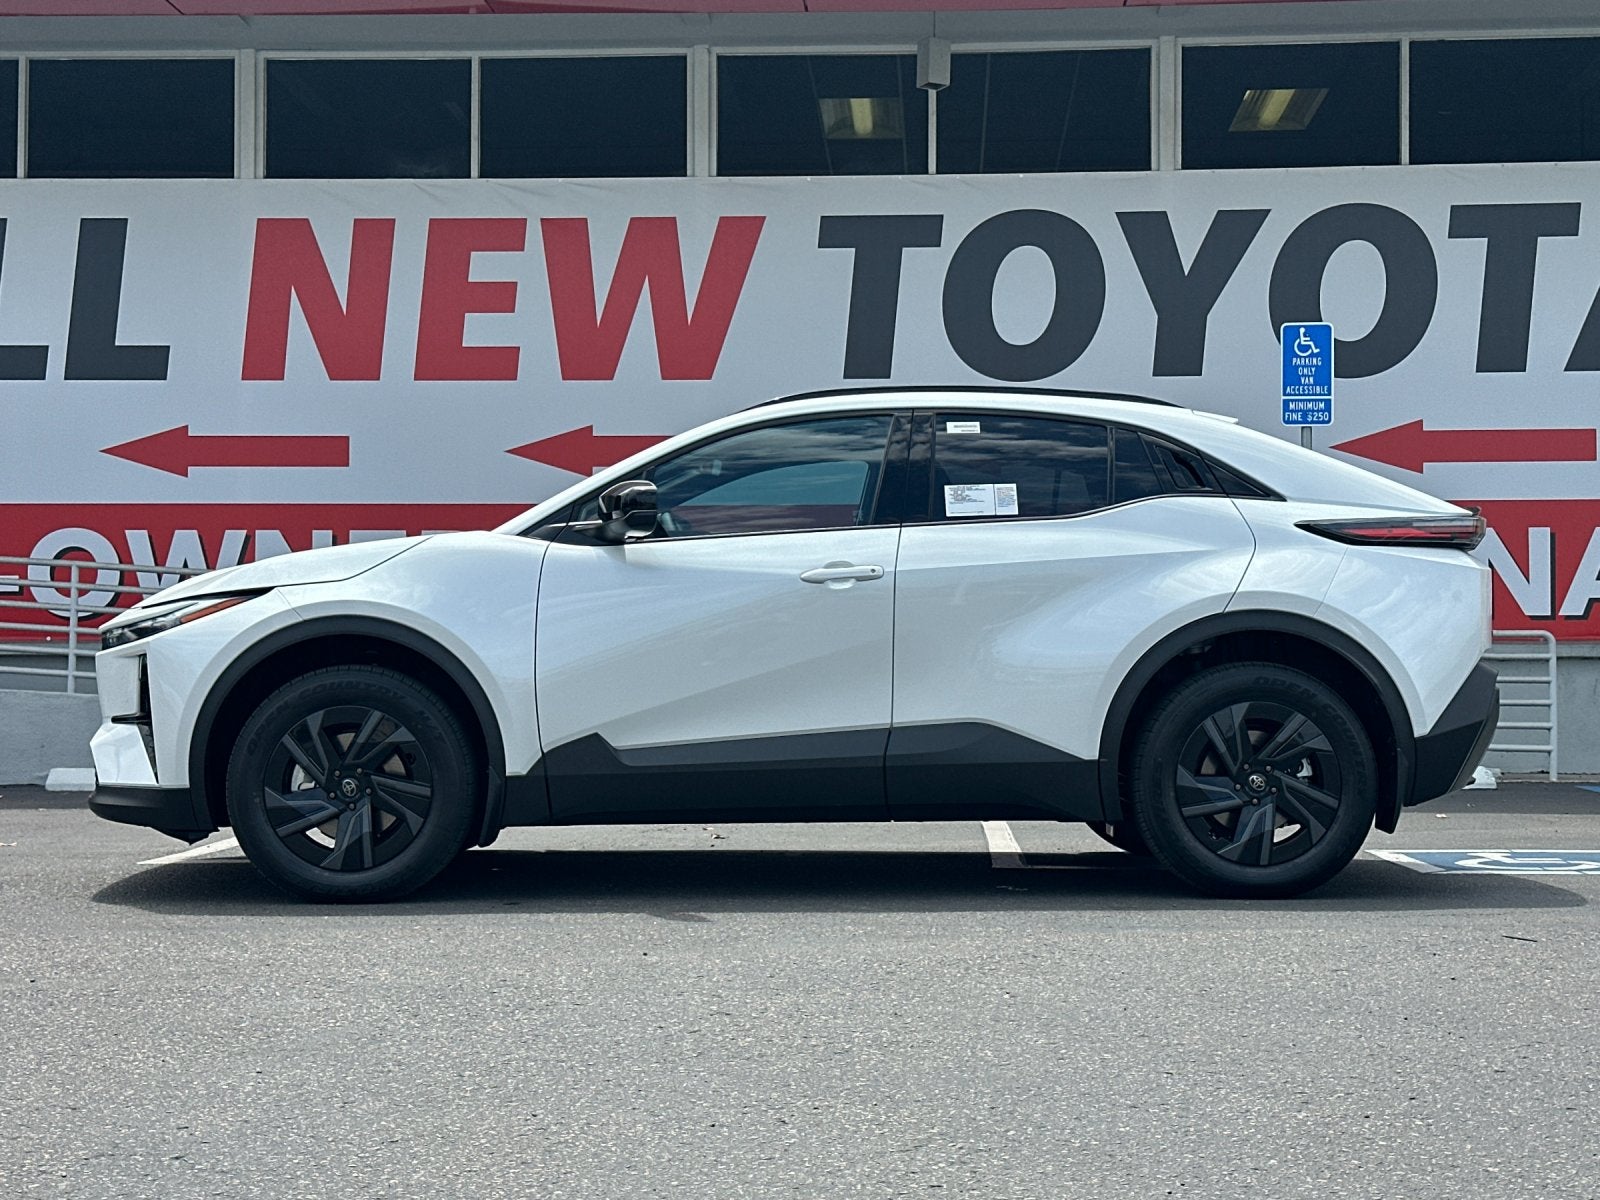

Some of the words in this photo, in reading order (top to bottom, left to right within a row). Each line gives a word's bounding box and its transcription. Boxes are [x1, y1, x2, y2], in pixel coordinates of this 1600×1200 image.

[241, 215, 766, 381] NEW
[817, 201, 1600, 382] TOYOT
[1292, 357, 1322, 366] PARKING
[1298, 367, 1316, 375] ONLY
[1300, 376, 1314, 385] VAN
[1285, 385, 1329, 394] ACCESSIBLE
[1288, 401, 1325, 410] MINIMUM
[1284, 411, 1303, 421] FINE
[1306, 411, 1329, 421] $250
